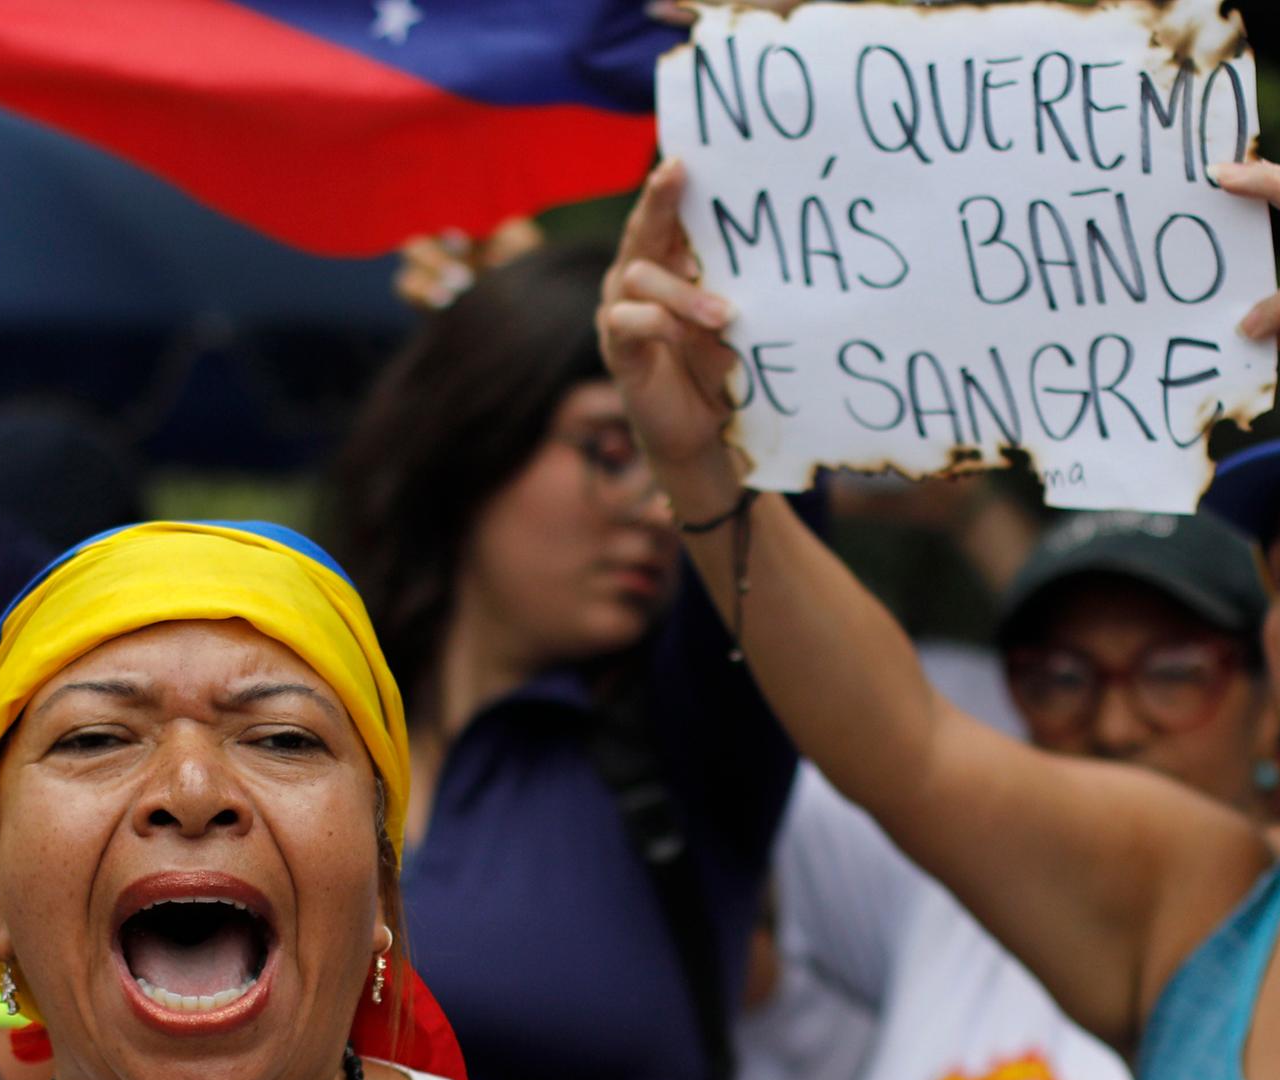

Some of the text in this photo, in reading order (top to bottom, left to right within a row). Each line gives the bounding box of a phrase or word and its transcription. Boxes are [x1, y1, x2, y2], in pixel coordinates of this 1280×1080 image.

[693, 36, 1249, 188] NO QUEREMO
[712, 154, 1224, 311] MÁS BAÑO
[837, 333, 1223, 449] SANGRE
